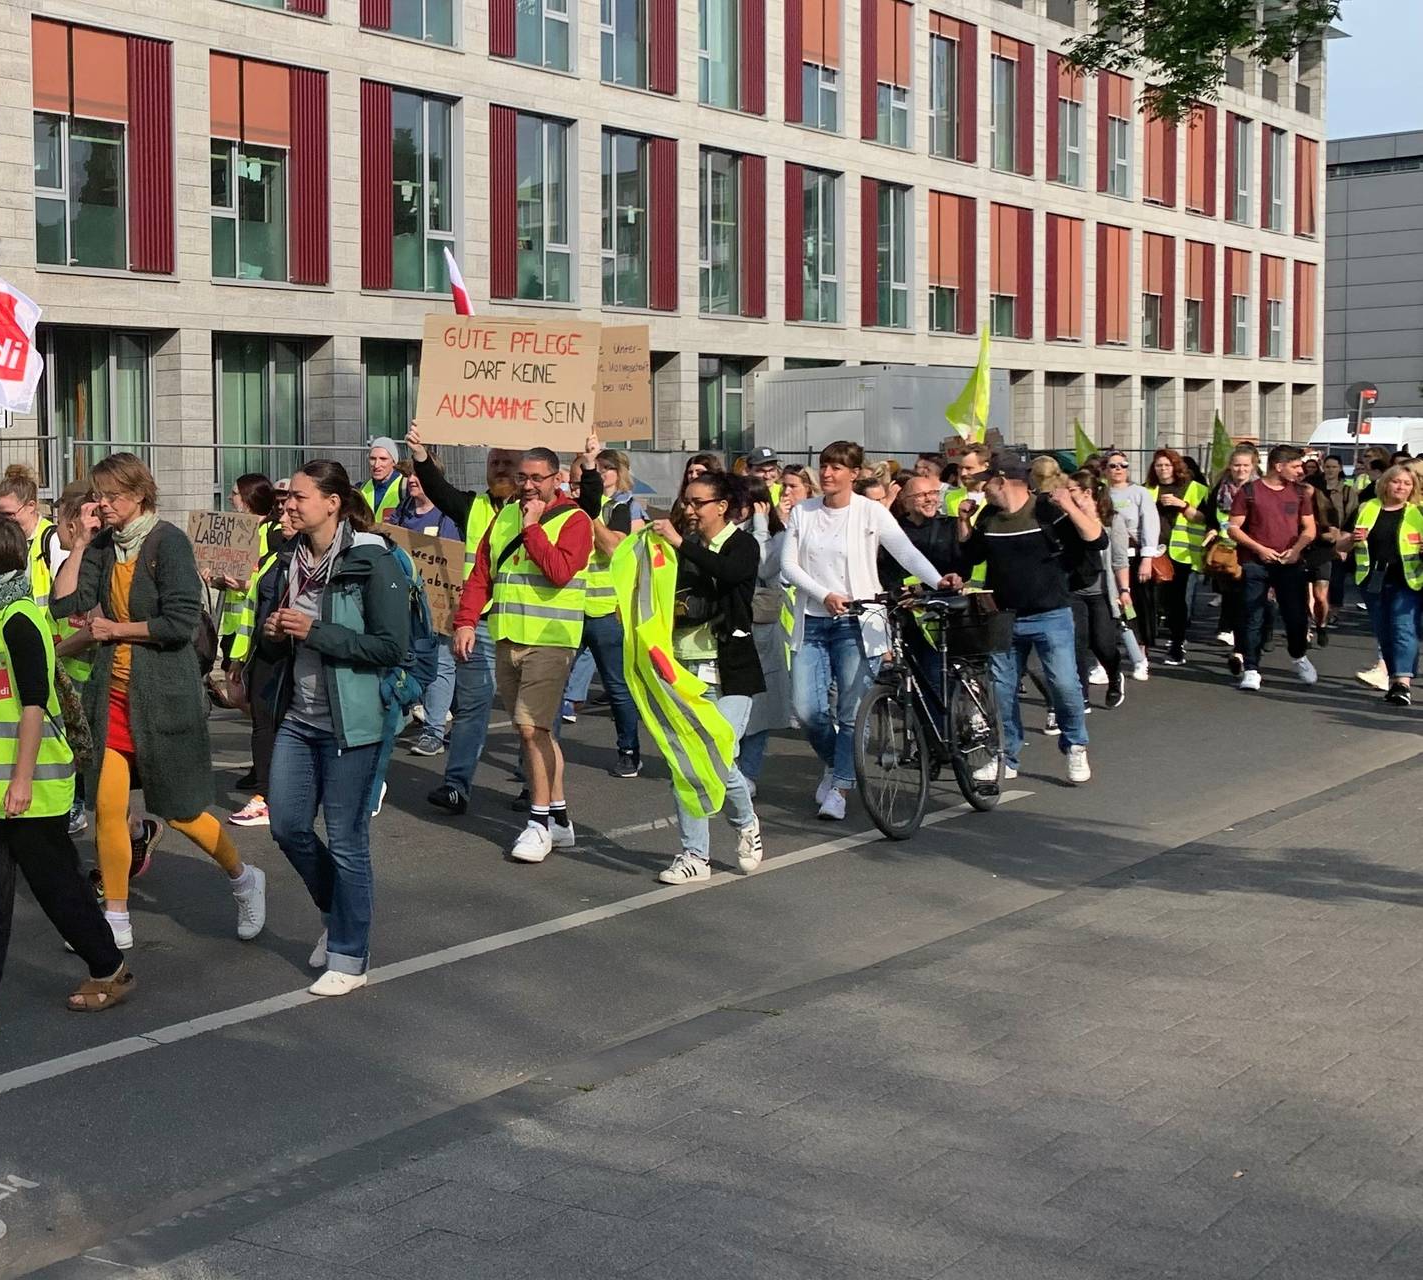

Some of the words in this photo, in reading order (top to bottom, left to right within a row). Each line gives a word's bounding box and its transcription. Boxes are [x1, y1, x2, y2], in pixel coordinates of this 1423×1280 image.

[443, 327, 497, 351] GUTE
[509, 331, 583, 356] PFLEGE
[463, 360, 506, 381] DARF
[510, 362, 558, 385] KEINE
[435, 394, 541, 421] AUSNAHME
[542, 400, 586, 424] SEIN
[195, 521, 232, 547] LABOR
[207, 512, 235, 531] TEAM
